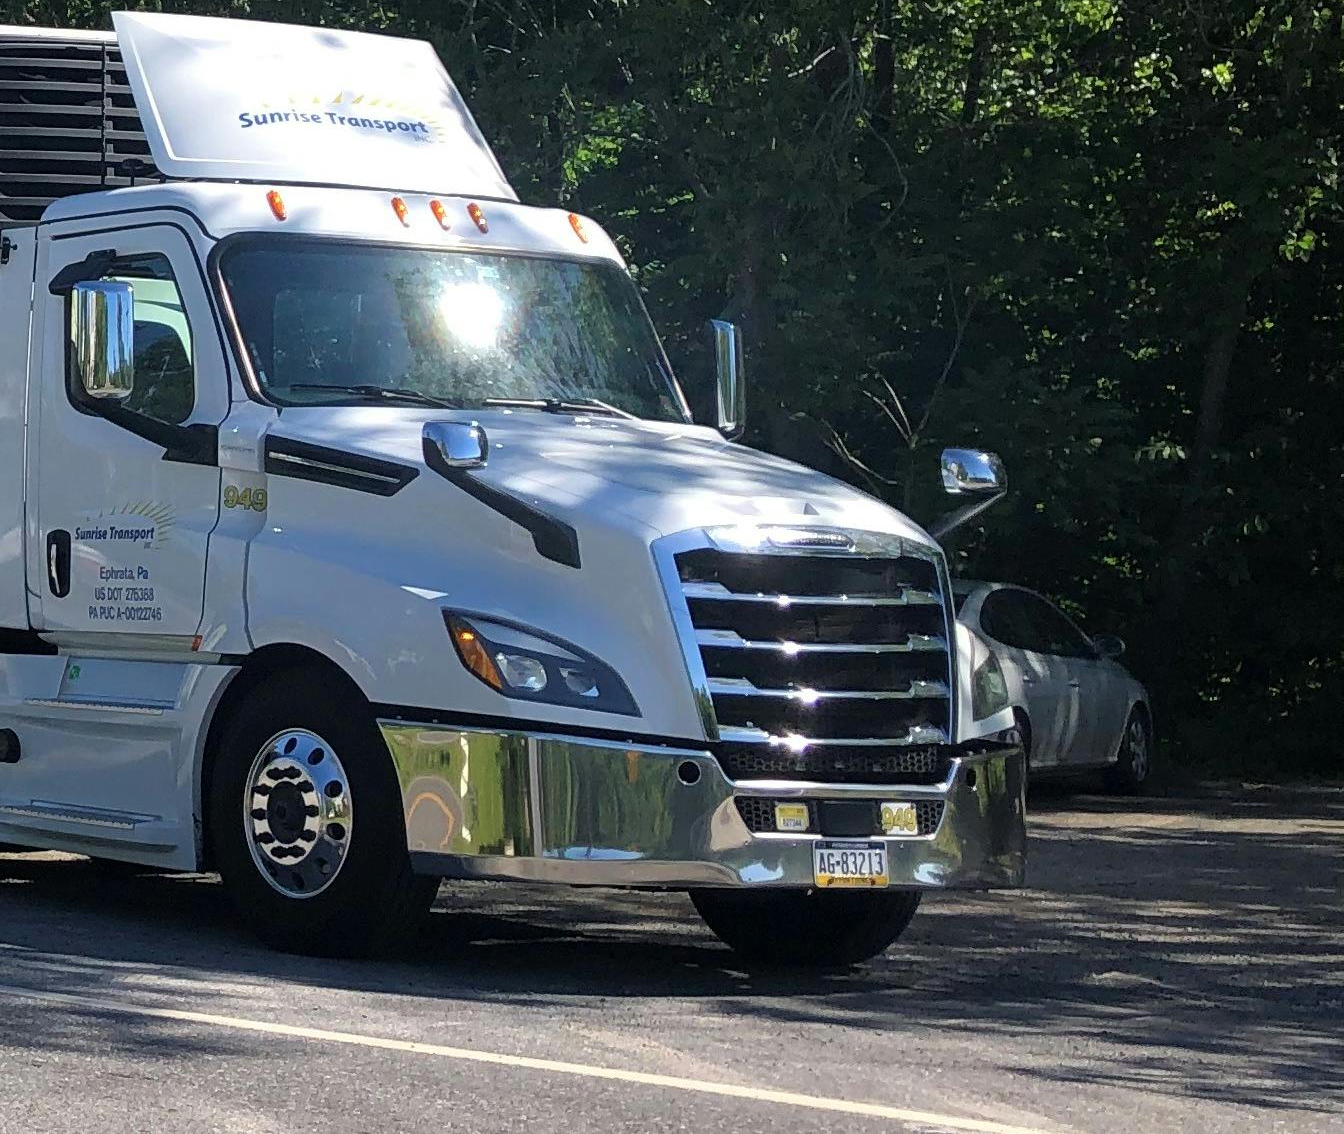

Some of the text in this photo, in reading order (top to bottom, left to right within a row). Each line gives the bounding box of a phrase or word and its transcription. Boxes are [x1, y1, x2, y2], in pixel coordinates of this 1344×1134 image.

[239, 109, 429, 133] Sunrise Transport
[223, 485, 268, 512] 949
[74, 526, 154, 542] Sunrise Transport
[99, 566, 149, 582] Ephrata, Pa
[94, 587, 106, 601] US
[107, 587, 123, 601] DOT
[88, 606, 98, 619] PA
[99, 606, 115, 620] PUC
[818, 851, 884, 875] AG-83213
